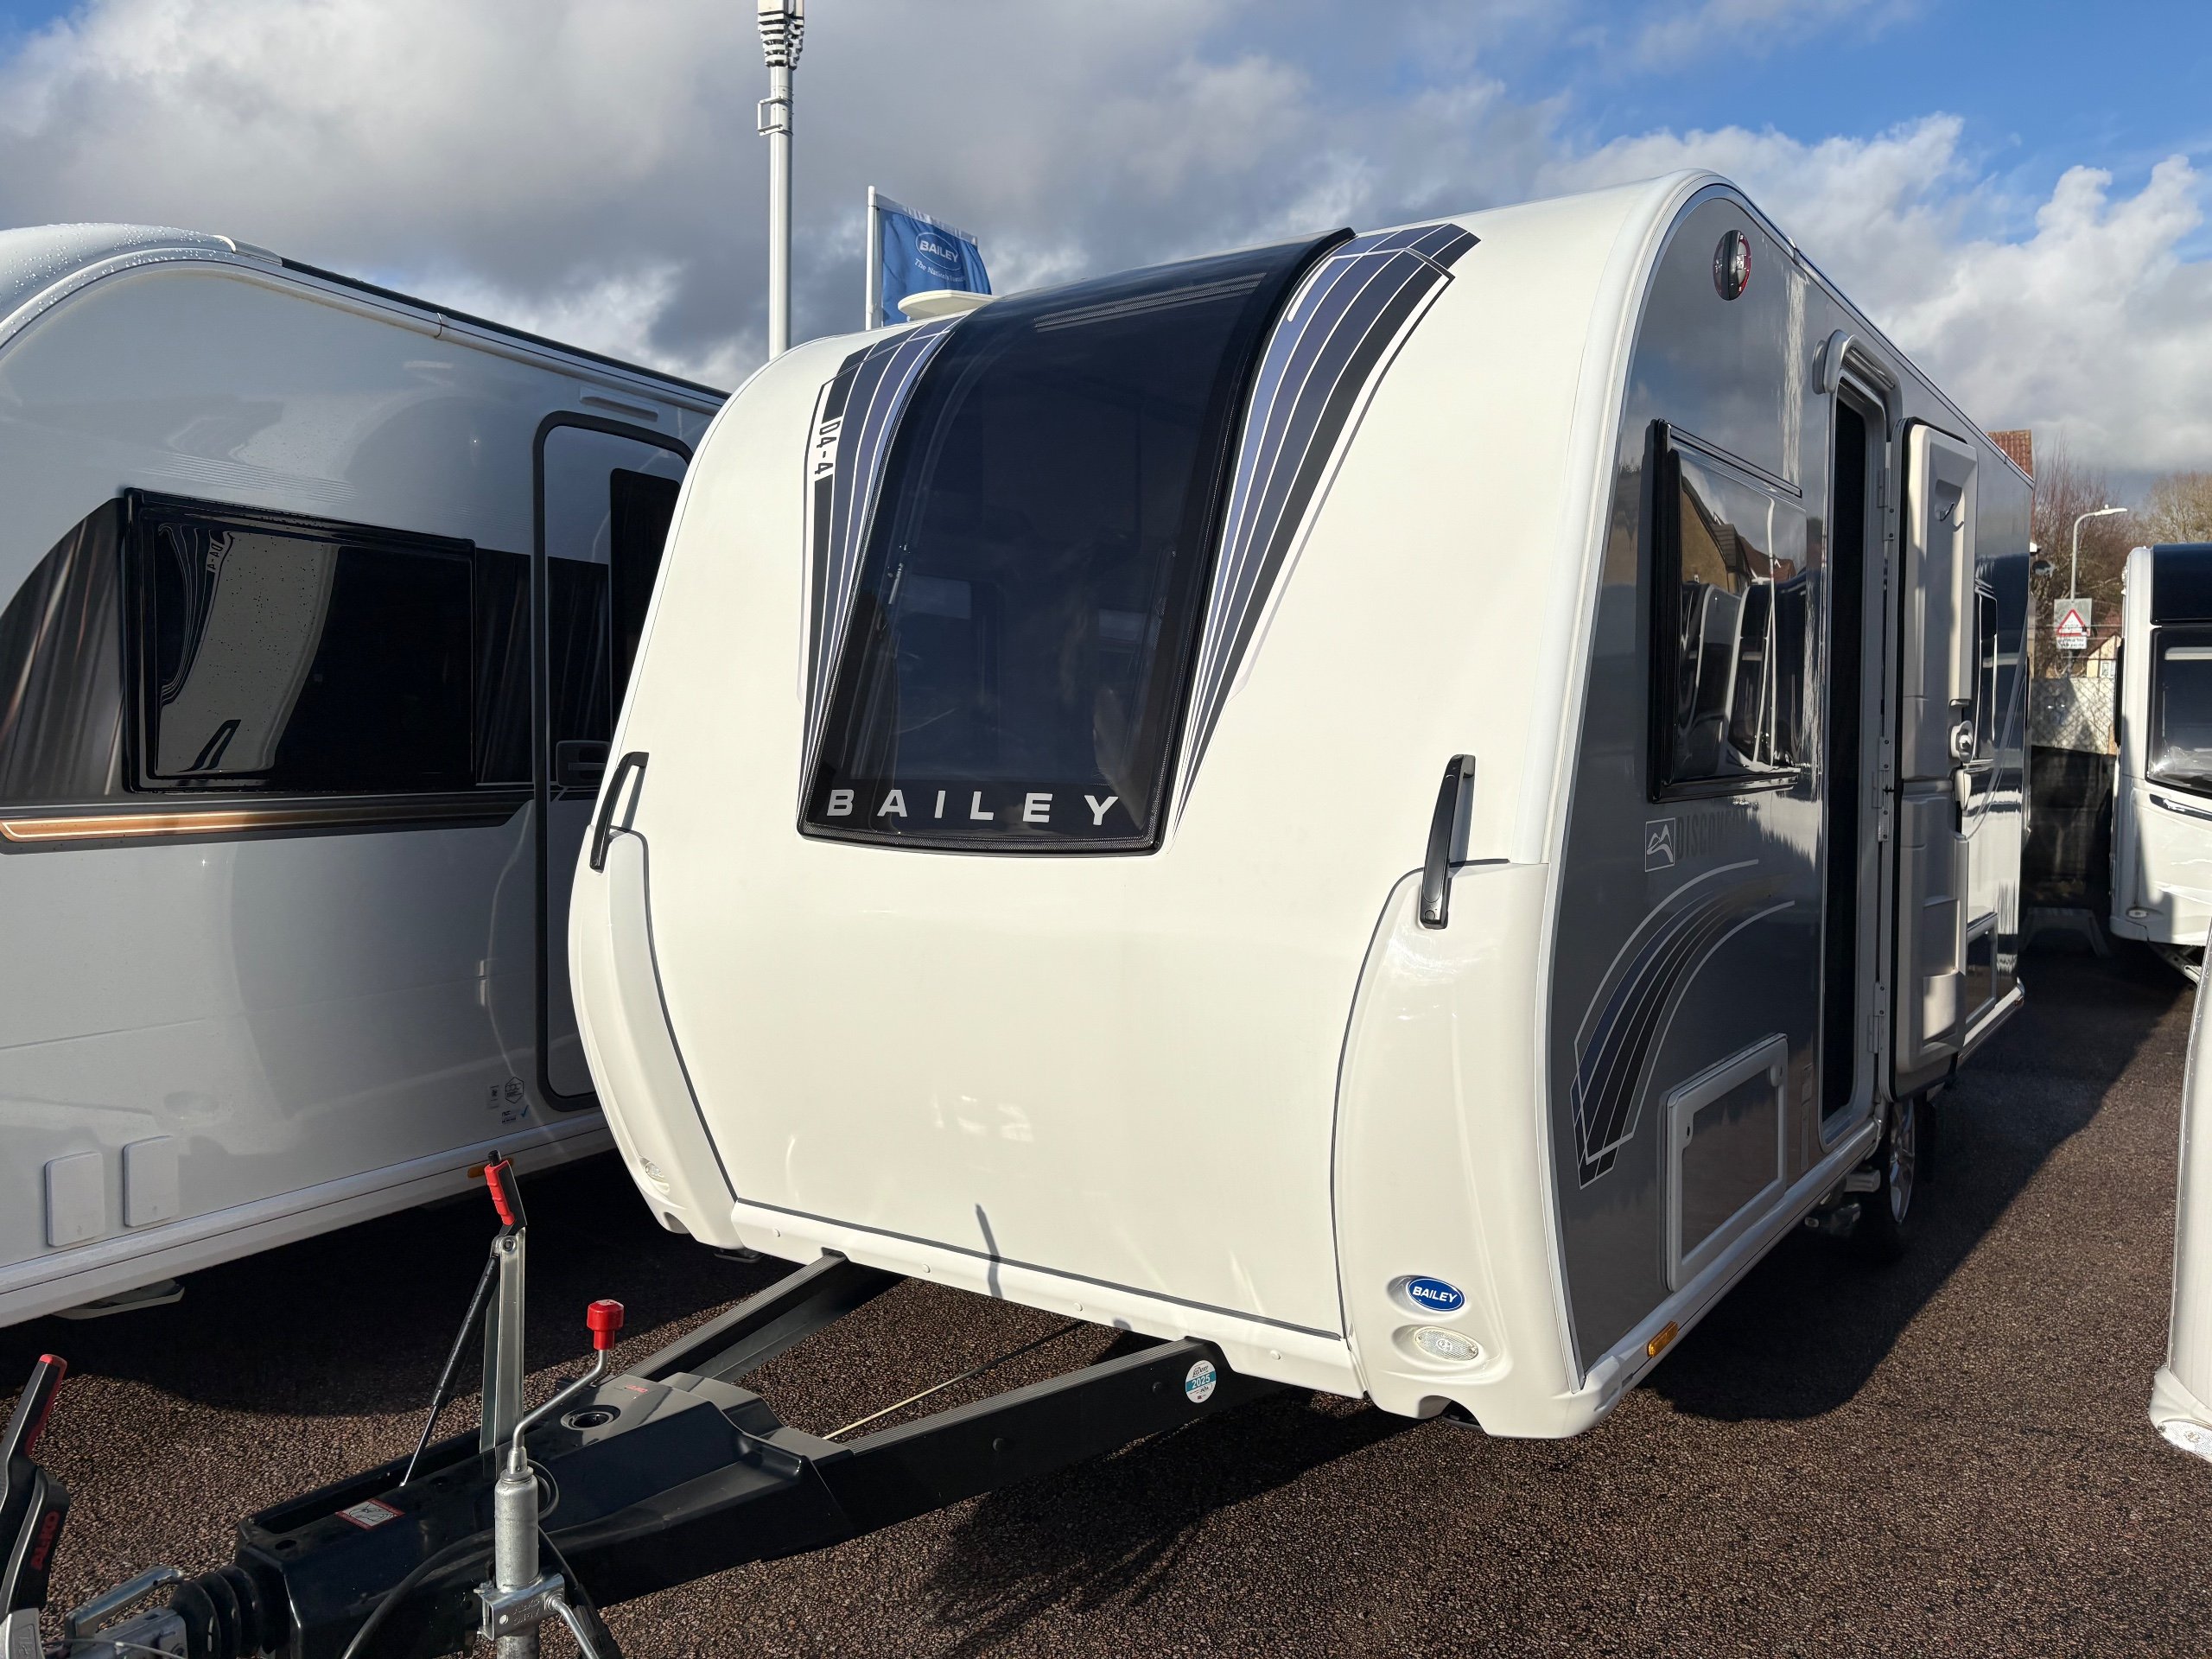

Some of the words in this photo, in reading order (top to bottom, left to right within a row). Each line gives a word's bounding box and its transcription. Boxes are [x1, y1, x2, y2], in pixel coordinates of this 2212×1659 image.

[919, 240, 958, 263] BAILEY
[914, 258, 926, 270] The
[814, 421, 841, 474] D4-4
[826, 788, 1120, 825] BAILEY
[1677, 808, 1747, 860] DISCOV
[1412, 1286, 1458, 1303] BAILEY
[1192, 1374, 1211, 1389] 2025
